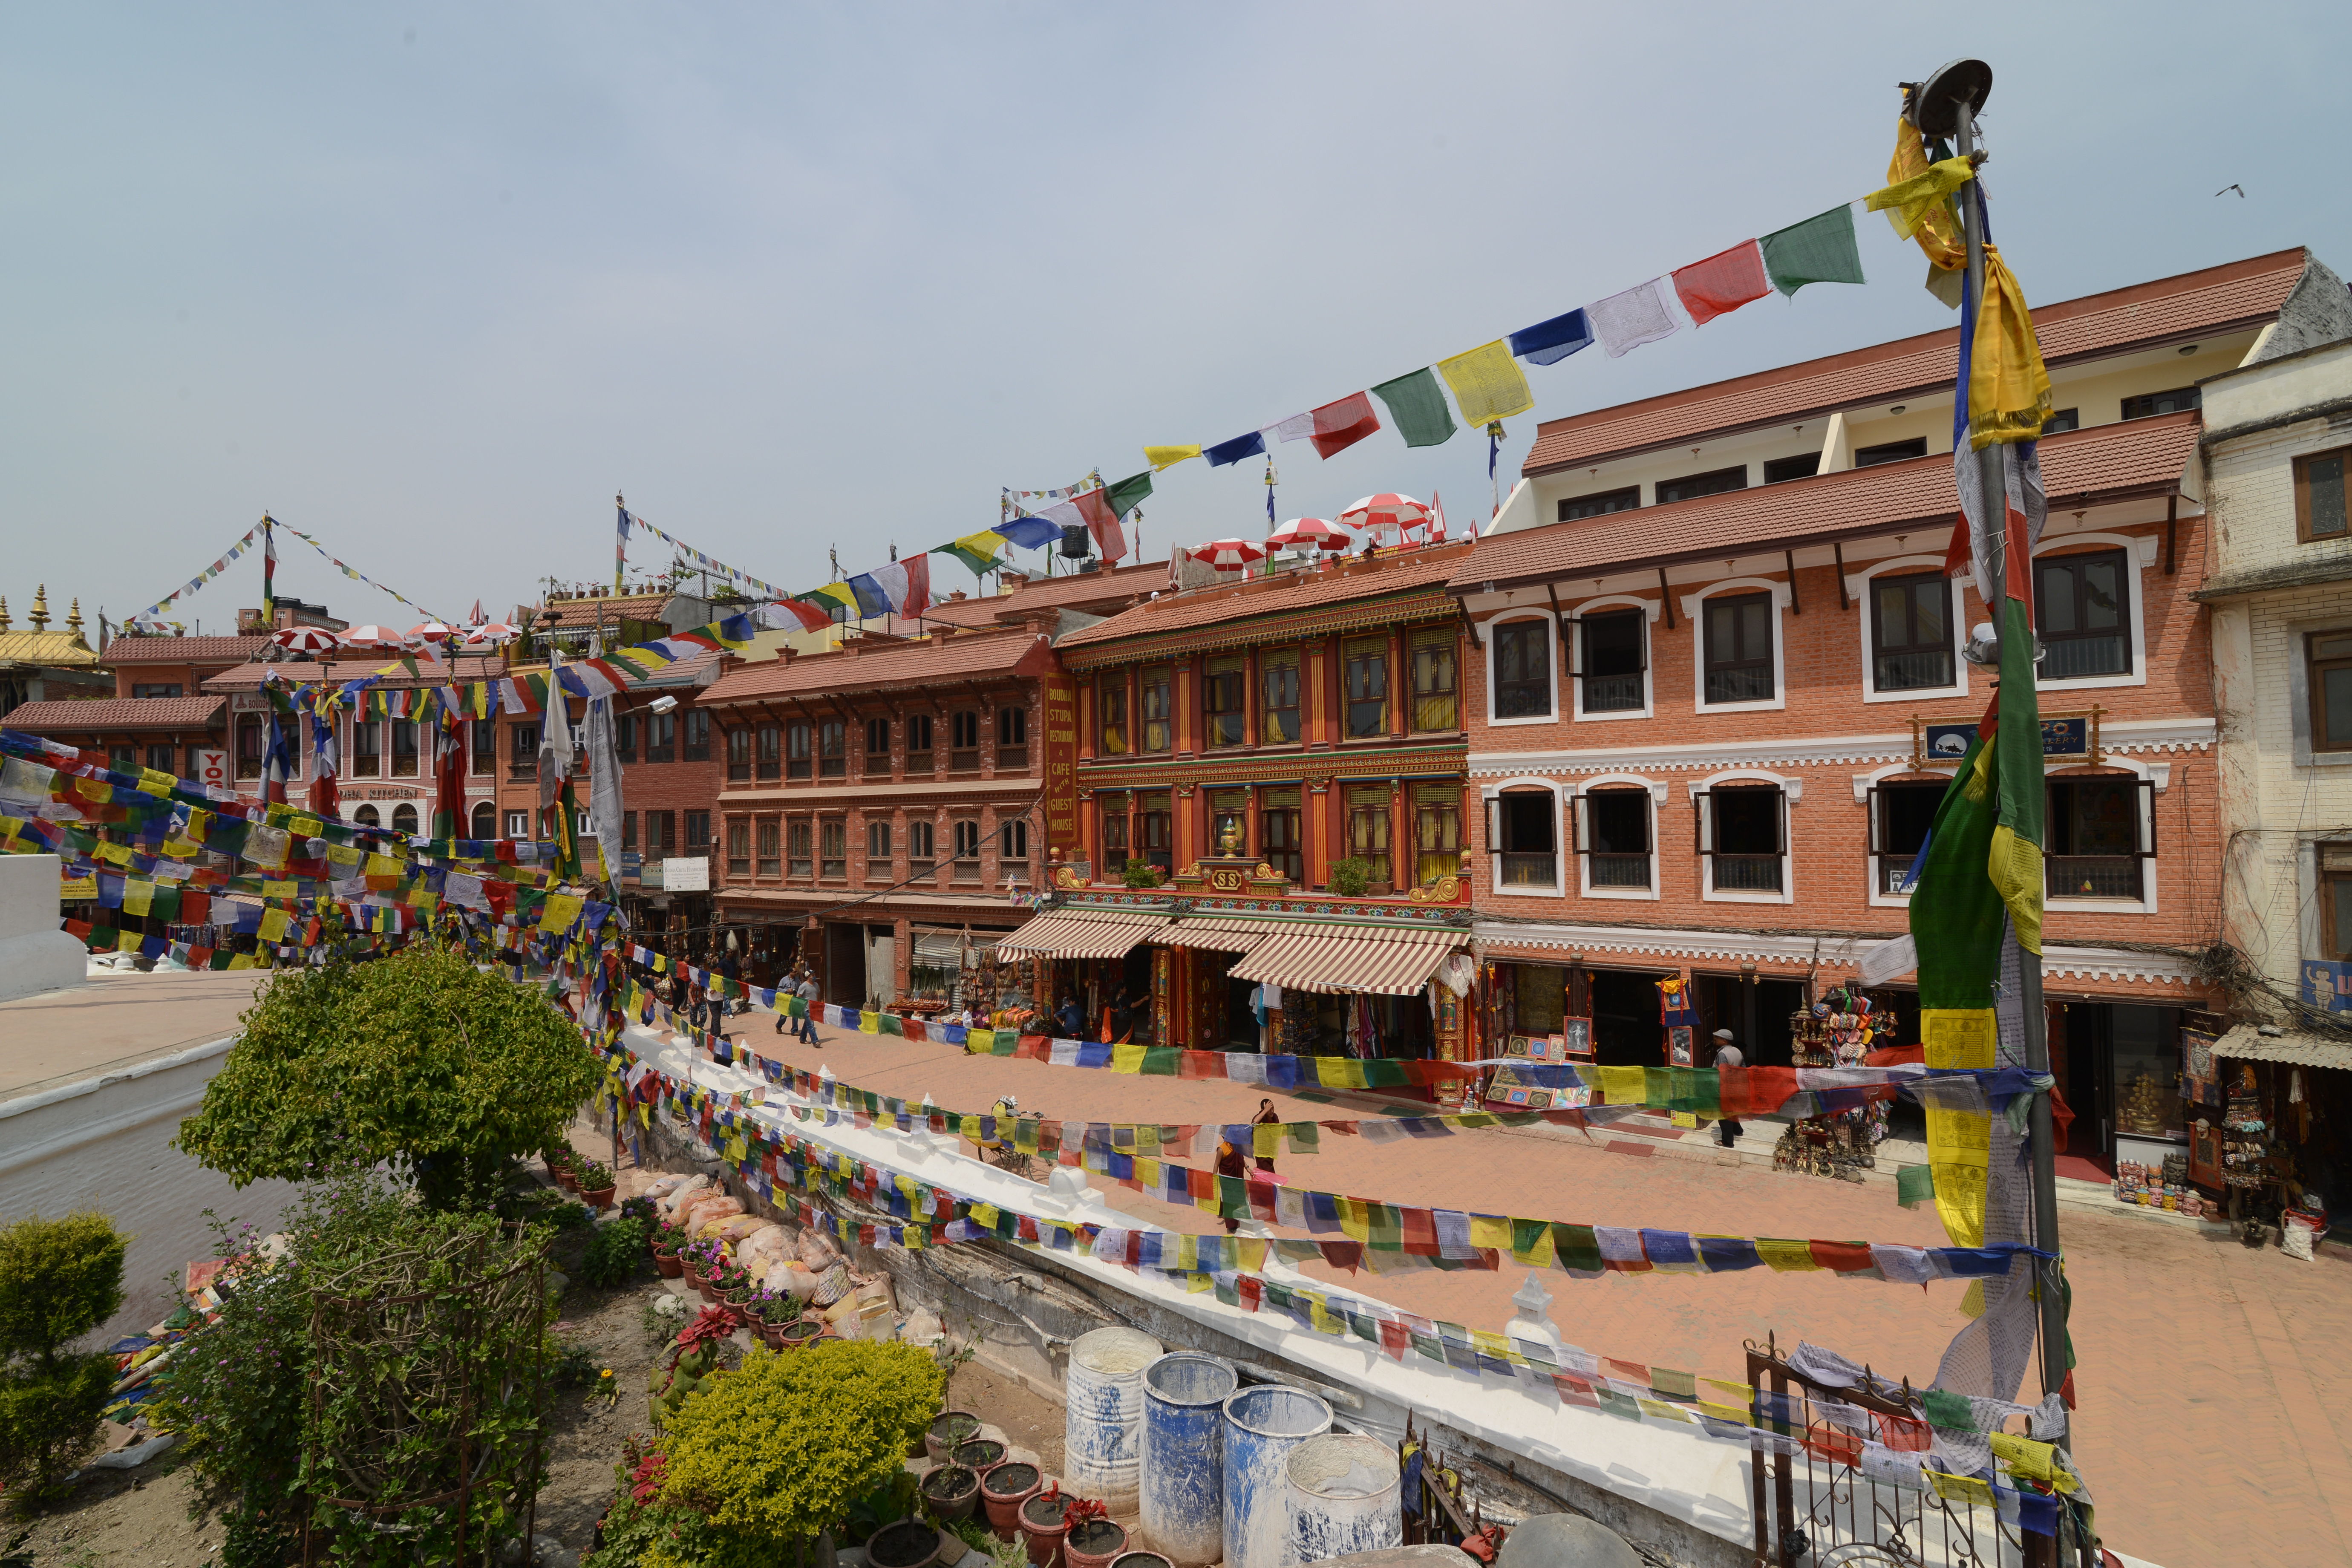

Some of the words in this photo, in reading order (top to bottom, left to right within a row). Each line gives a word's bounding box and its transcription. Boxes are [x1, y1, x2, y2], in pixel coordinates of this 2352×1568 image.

[1049, 688, 1072, 702] BOUDHA
[248, 699, 269, 708] BOUDDH
[1049, 709, 1072, 722] STUPA
[1049, 730, 1072, 742] RESTAURANT
[1052, 763, 1070, 775] CAFE
[1054, 778, 1069, 793] WITH
[339, 789, 362, 798] DHA
[368, 788, 417, 798] KITCHEN
[1051, 798, 1072, 811] GUEST
[1052, 819, 1072, 831] HOUSE
